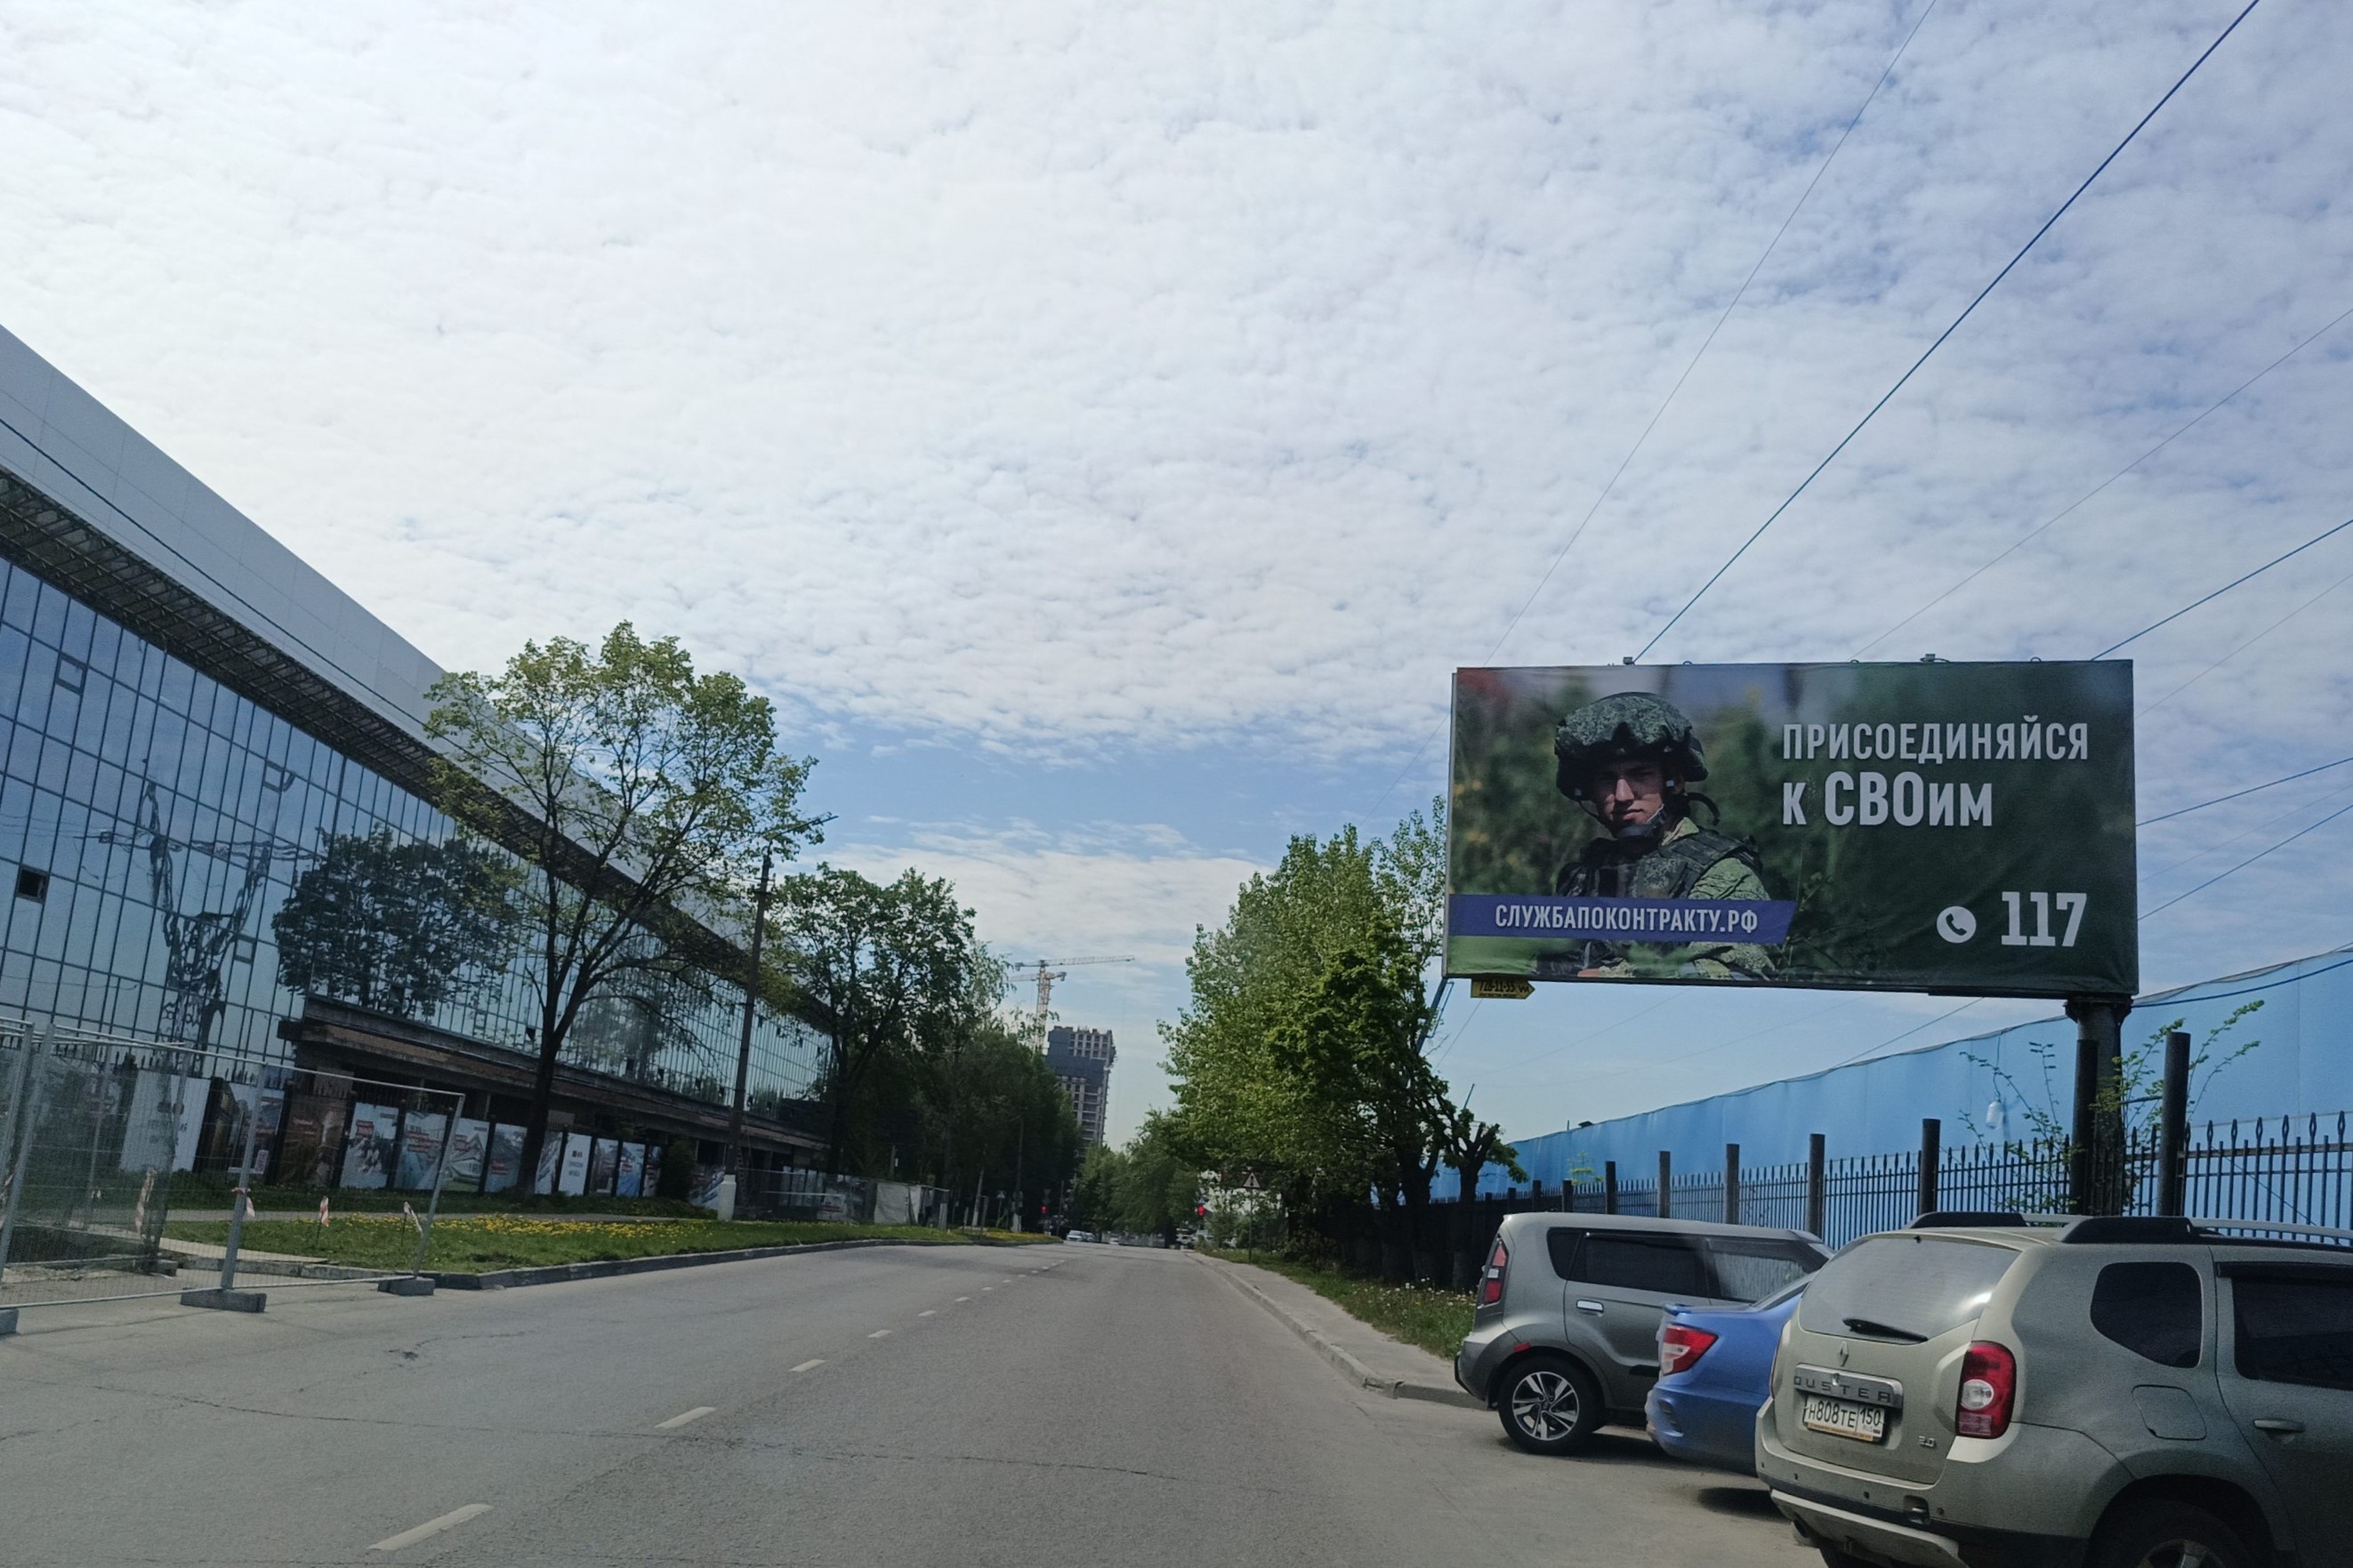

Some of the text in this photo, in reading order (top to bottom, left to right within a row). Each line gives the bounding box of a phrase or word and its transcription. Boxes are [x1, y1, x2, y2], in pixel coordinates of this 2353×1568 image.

[1783, 714, 2088, 764] ПРИСОЕДИНЯЙСЯ
[1495, 904, 1758, 934] СЛУЖБАПОКОНТРАКТУ.РФ
[2002, 891, 2087, 947] 117
[1793, 1376, 1891, 1403] DUSTER
[1860, 1407, 1882, 1427] 150
